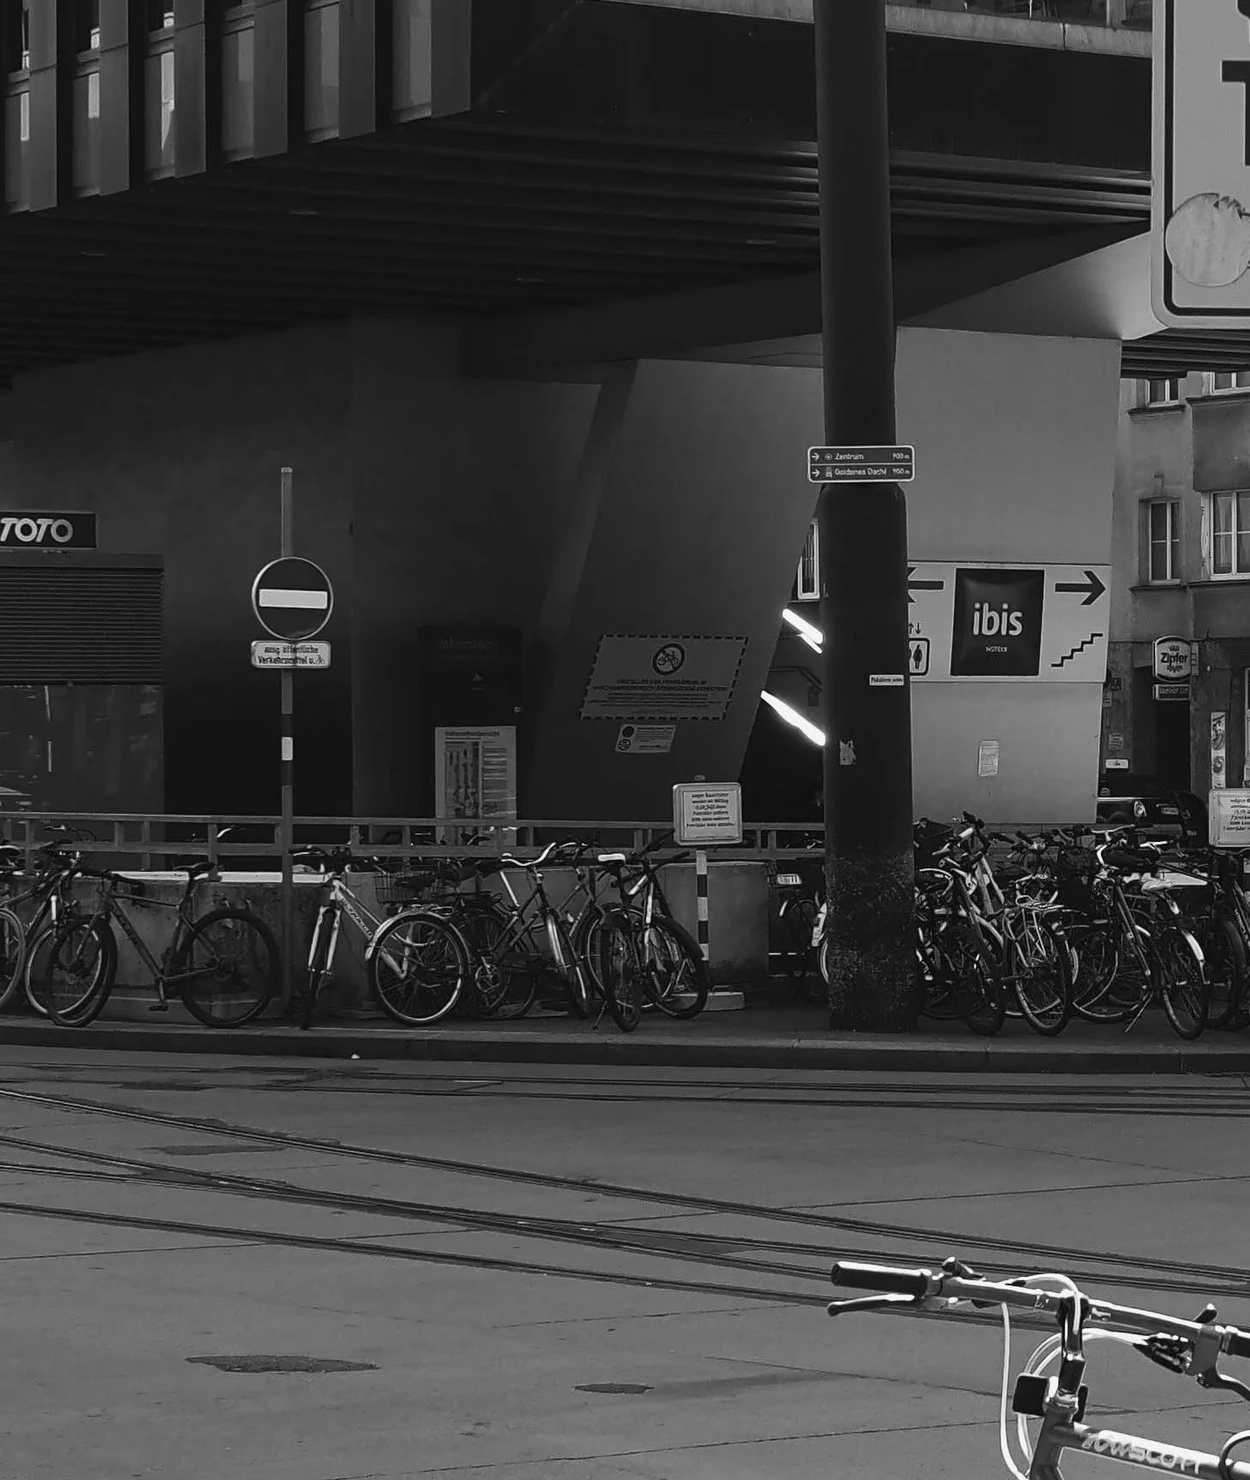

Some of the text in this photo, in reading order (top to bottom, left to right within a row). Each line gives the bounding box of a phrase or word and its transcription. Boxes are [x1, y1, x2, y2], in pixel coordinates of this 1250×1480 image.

[834, 452, 865, 461] Zentrum
[0, 517, 74, 543] TOTO
[972, 602, 1023, 636] ibis
[1160, 652, 1188, 666] Zipfer
